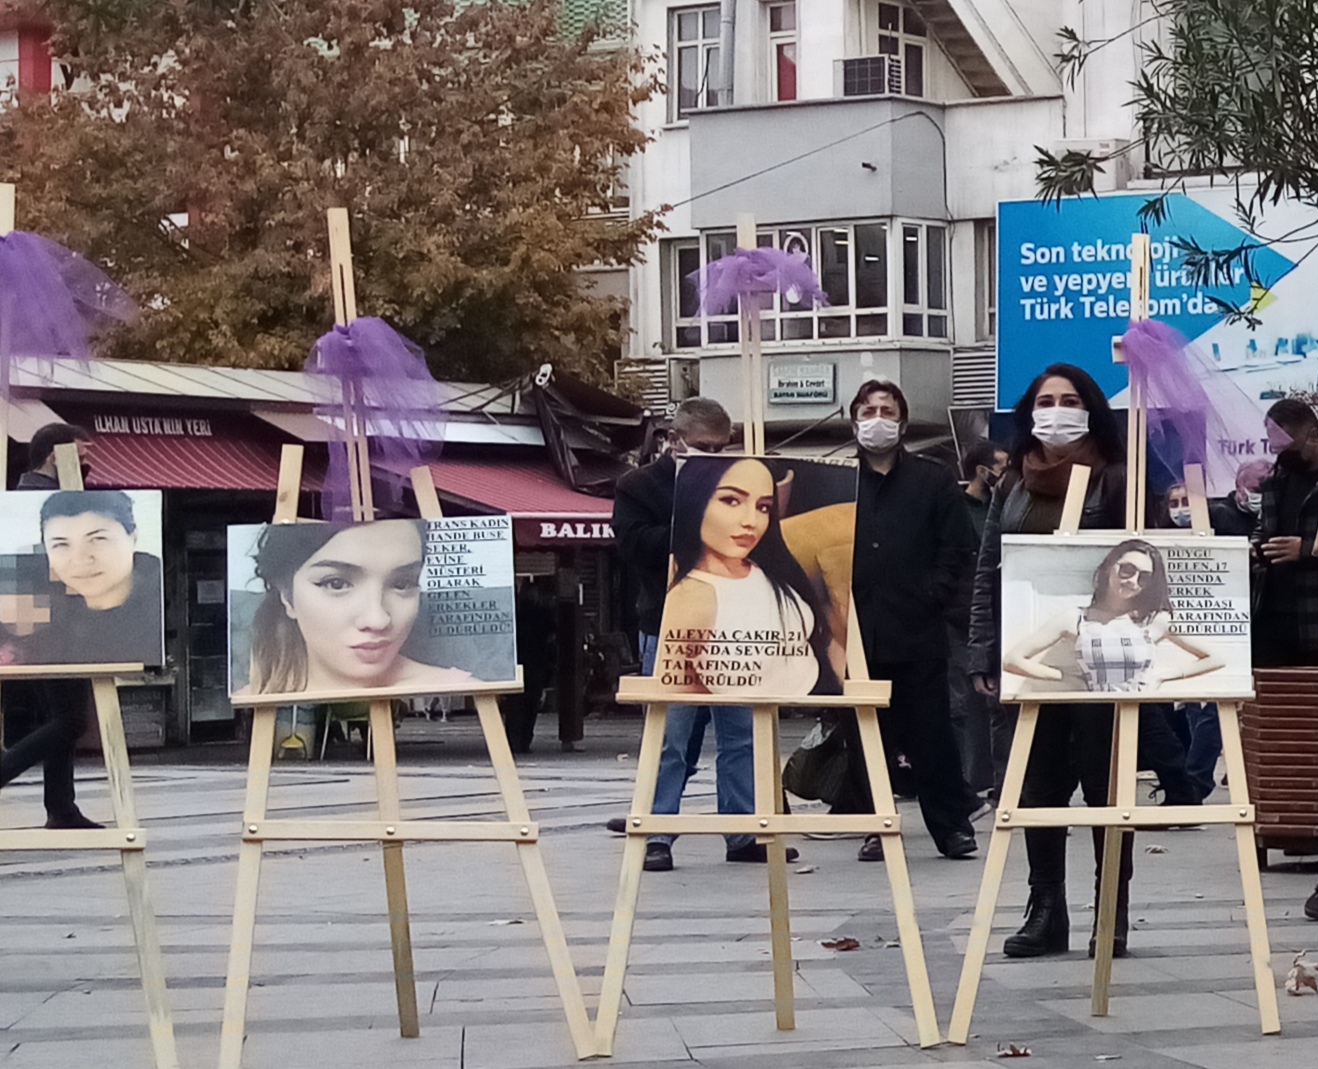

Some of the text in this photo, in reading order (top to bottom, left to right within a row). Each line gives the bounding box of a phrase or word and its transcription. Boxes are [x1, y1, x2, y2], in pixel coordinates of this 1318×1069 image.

[1020, 242, 1065, 265] Son
[1019, 274, 1048, 293] ve
[1020, 297, 1074, 320] Türk
[1218, 439, 1255, 456] Türk
[470, 518, 509, 528] KADIN
[473, 530, 504, 540] BUSE
[540, 522, 615, 538] BALIK
[1167, 549, 1211, 558] DUYGU
[1216, 562, 1227, 570] 17
[427, 578, 481, 588] OLARAK
[1168, 587, 1212, 595] ERKEK
[1168, 612, 1249, 621] TARAFINDAN
[665, 629, 728, 640] ALEYNA
[788, 631, 801, 641] 21
[663, 659, 762, 672] TARAFINDAN
